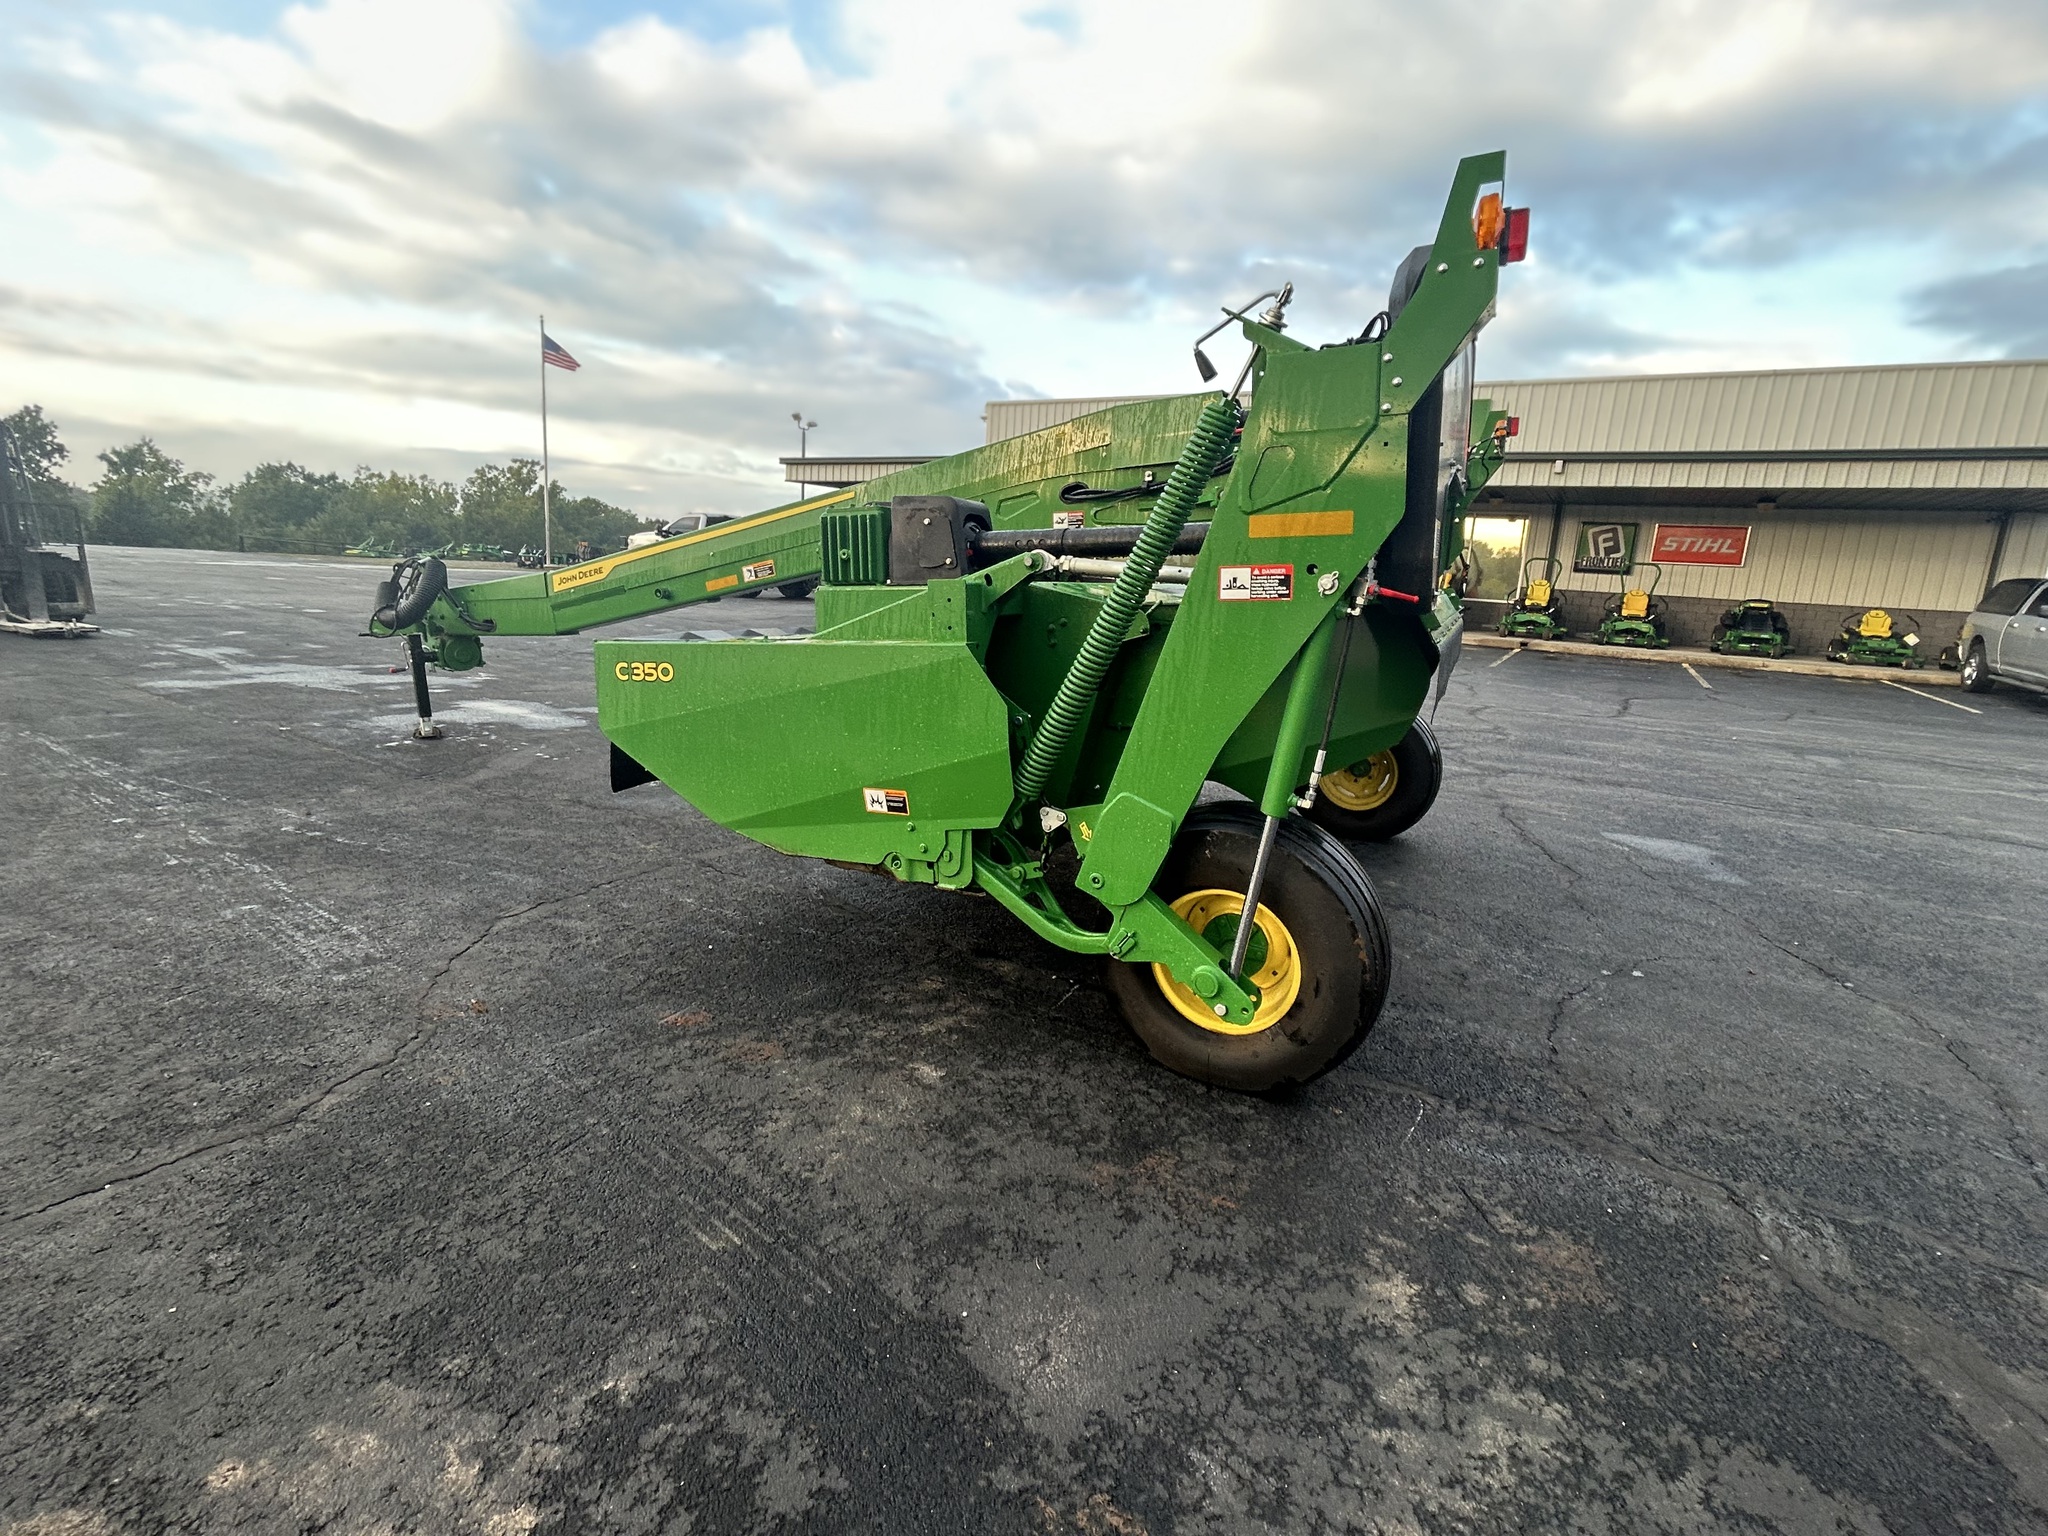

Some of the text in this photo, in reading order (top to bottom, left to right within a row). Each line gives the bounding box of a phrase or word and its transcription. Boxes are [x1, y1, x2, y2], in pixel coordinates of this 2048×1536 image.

[1660, 536, 1738, 553] STIHL
[1580, 556, 1627, 568] FRONTIER
[557, 566, 604, 586] JOHN DEERE
[614, 661, 675, 683] C350
